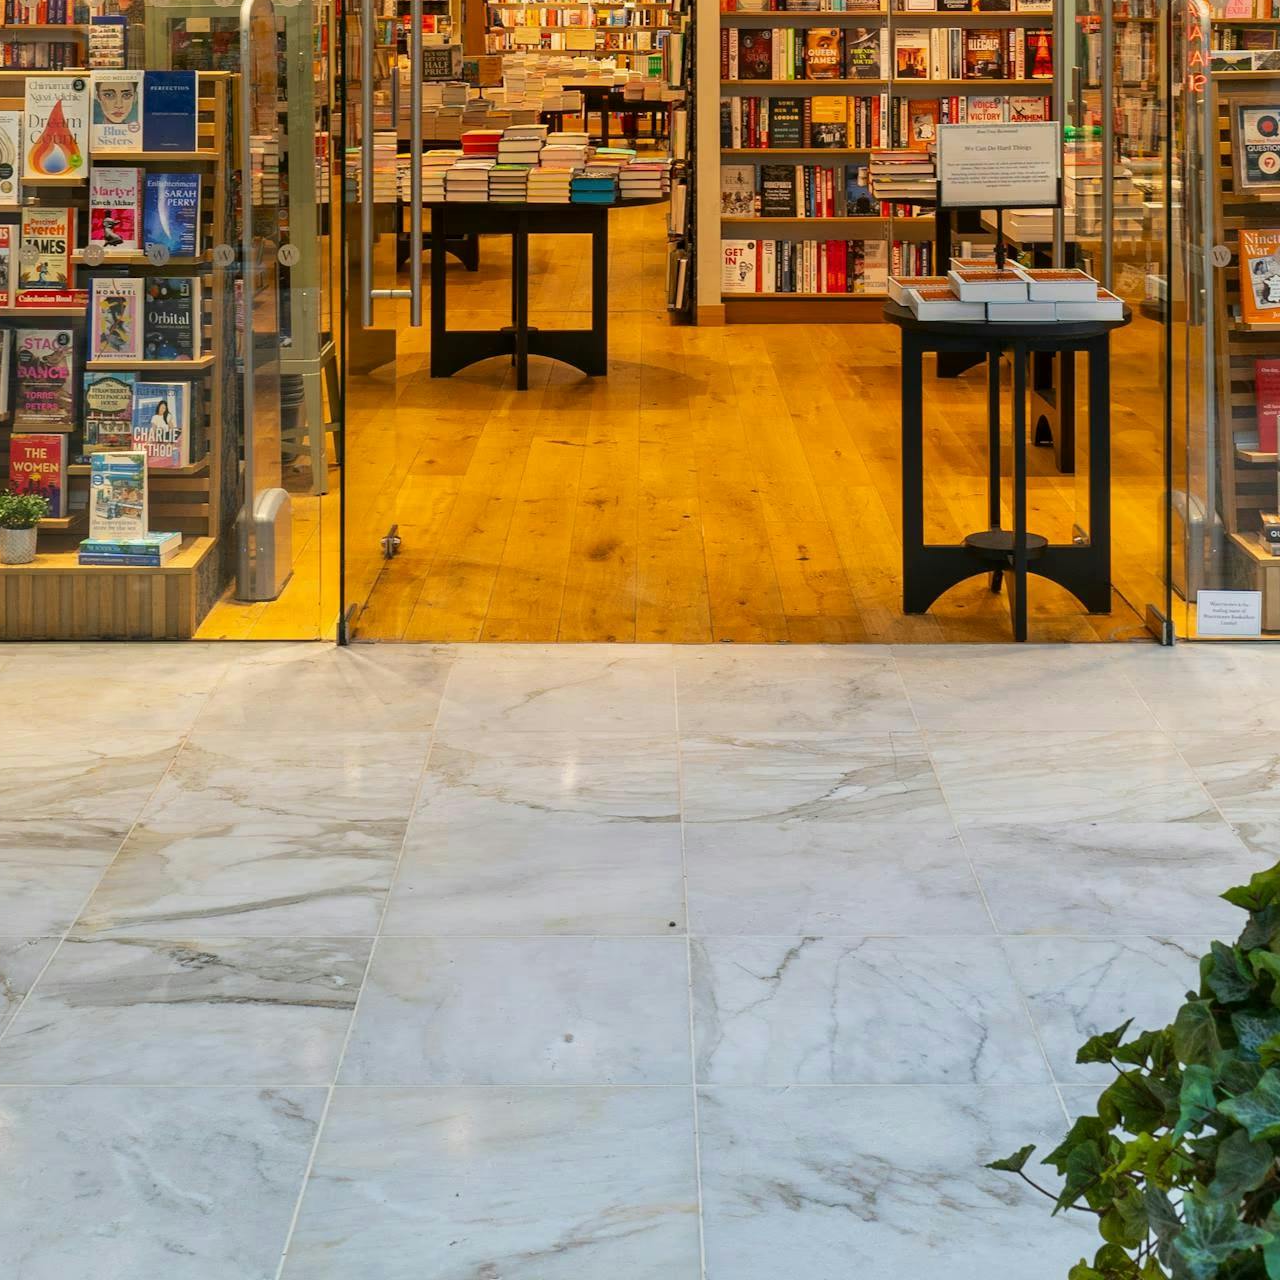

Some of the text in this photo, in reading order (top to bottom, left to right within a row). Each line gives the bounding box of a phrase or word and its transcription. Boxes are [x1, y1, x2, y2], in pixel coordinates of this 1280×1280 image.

[807, 49, 837, 57] QUEEN
[807, 57, 837, 65] JAMES
[972, 101, 998, 109] VOICES
[28, 113, 82, 129] Dream
[970, 113, 1001, 121] VICTORY
[103, 125, 128, 137] Blue
[30, 132, 79, 146] Count
[97, 136, 134, 145] Sisters
[91, 185, 136, 198] Martyr!
[164, 189, 197, 198] SARAH
[167, 198, 197, 207] PERRY
[23, 224, 65, 236] Everett
[25, 238, 66, 255] JAMES
[1244, 244, 1269, 256] War
[724, 248, 744, 257] GET
[724, 257, 737, 266] IN
[148, 311, 190, 325] Orbital
[17, 366, 68, 379] DANCE
[25, 402, 59, 411] PETERS
[133, 426, 179, 443] CHARLIE
[24, 448, 48, 459] THE
[13, 461, 59, 473] WOMEN
